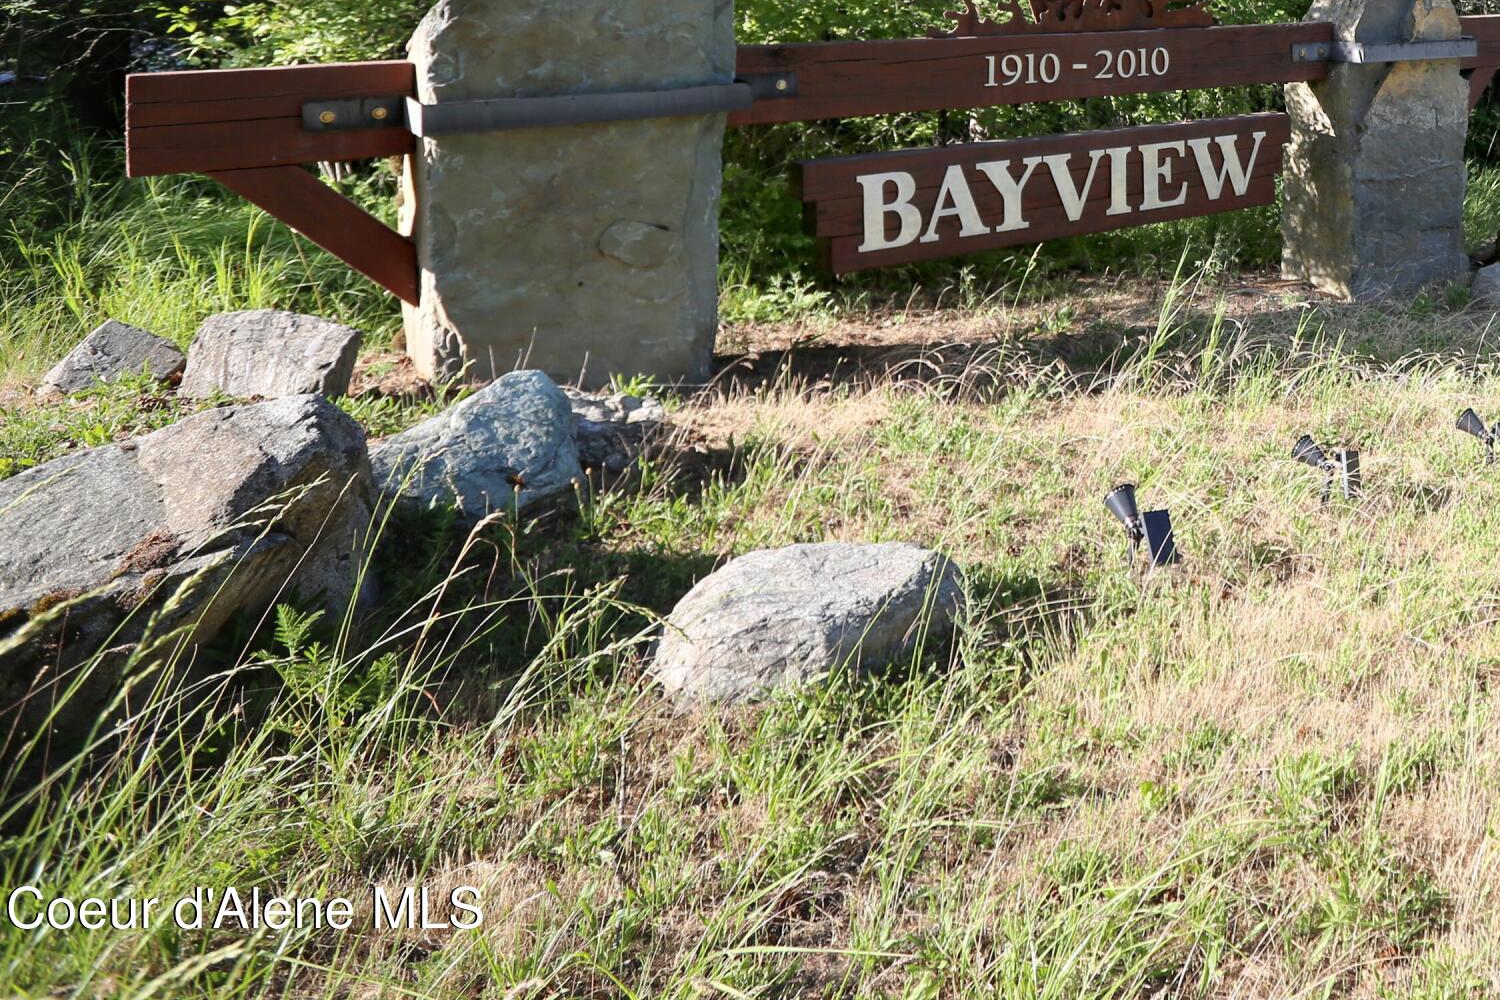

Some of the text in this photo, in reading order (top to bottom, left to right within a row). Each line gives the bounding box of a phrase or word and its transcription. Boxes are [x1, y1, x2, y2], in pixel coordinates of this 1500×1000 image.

[984, 53, 1060, 87] 1910
[1094, 47, 1169, 79] 2010
[856, 131, 1267, 253] BAYVIEW
